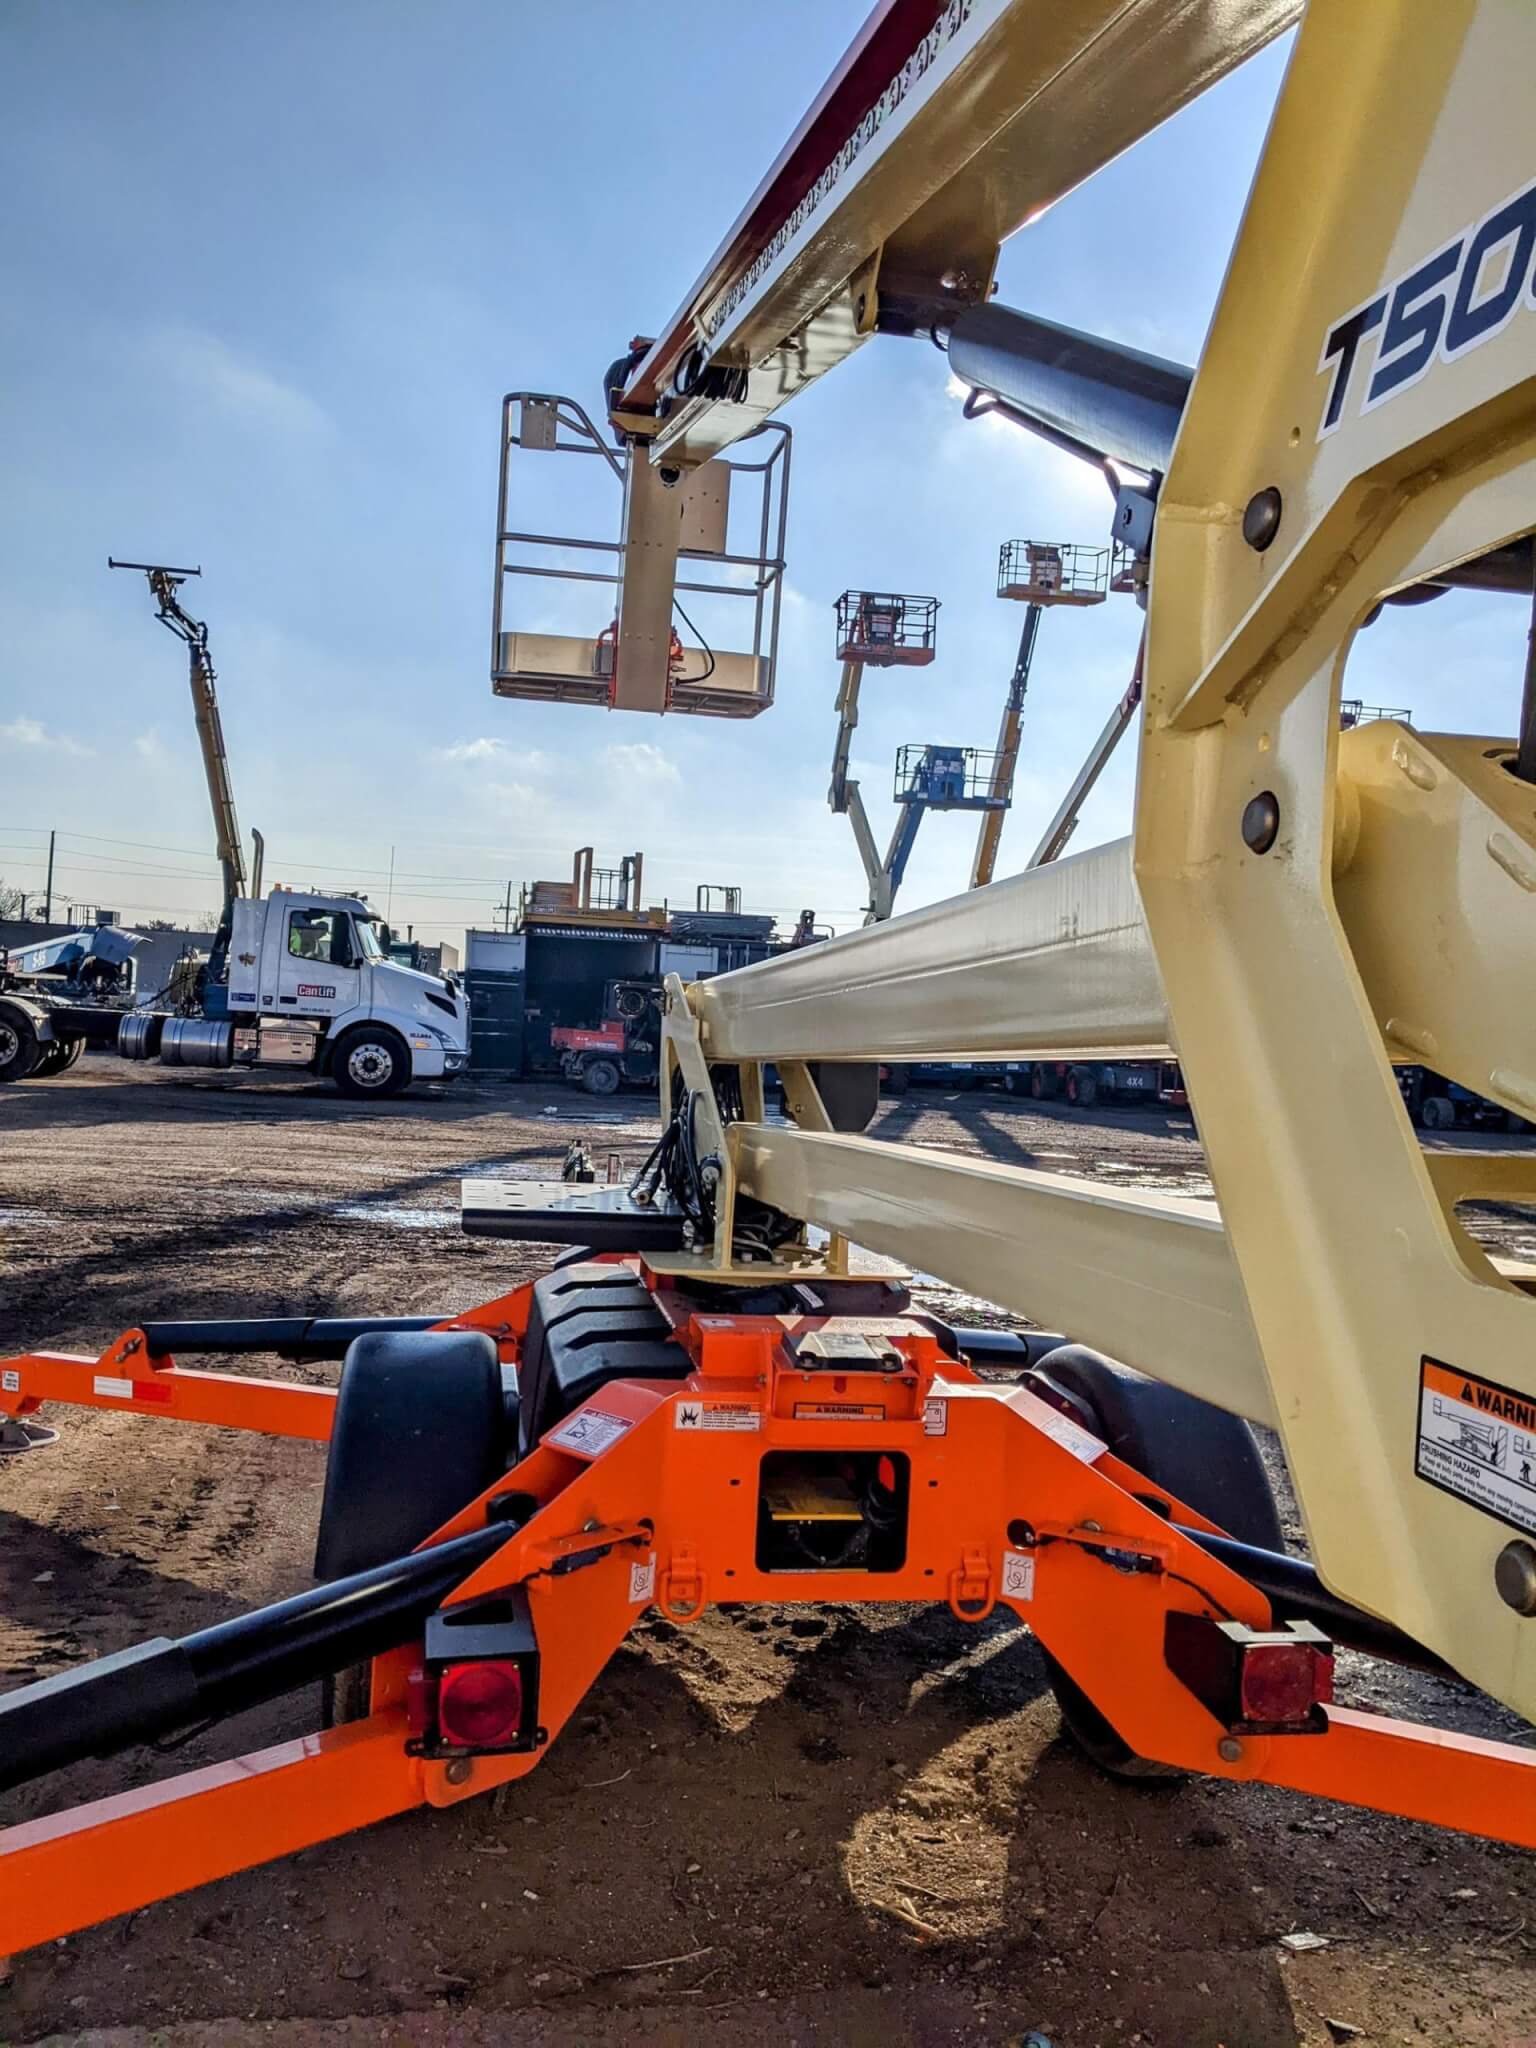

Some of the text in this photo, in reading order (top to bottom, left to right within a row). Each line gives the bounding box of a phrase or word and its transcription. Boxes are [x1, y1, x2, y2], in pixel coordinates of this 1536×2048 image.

[1320, 182, 1536, 432] T50
[298, 985, 335, 999] CanLift
[1126, 1077, 1144, 1087] 4X4
[824, 1406, 864, 1415] WARNING
[1420, 1442, 1481, 1479] CRUSHING HAZARD
